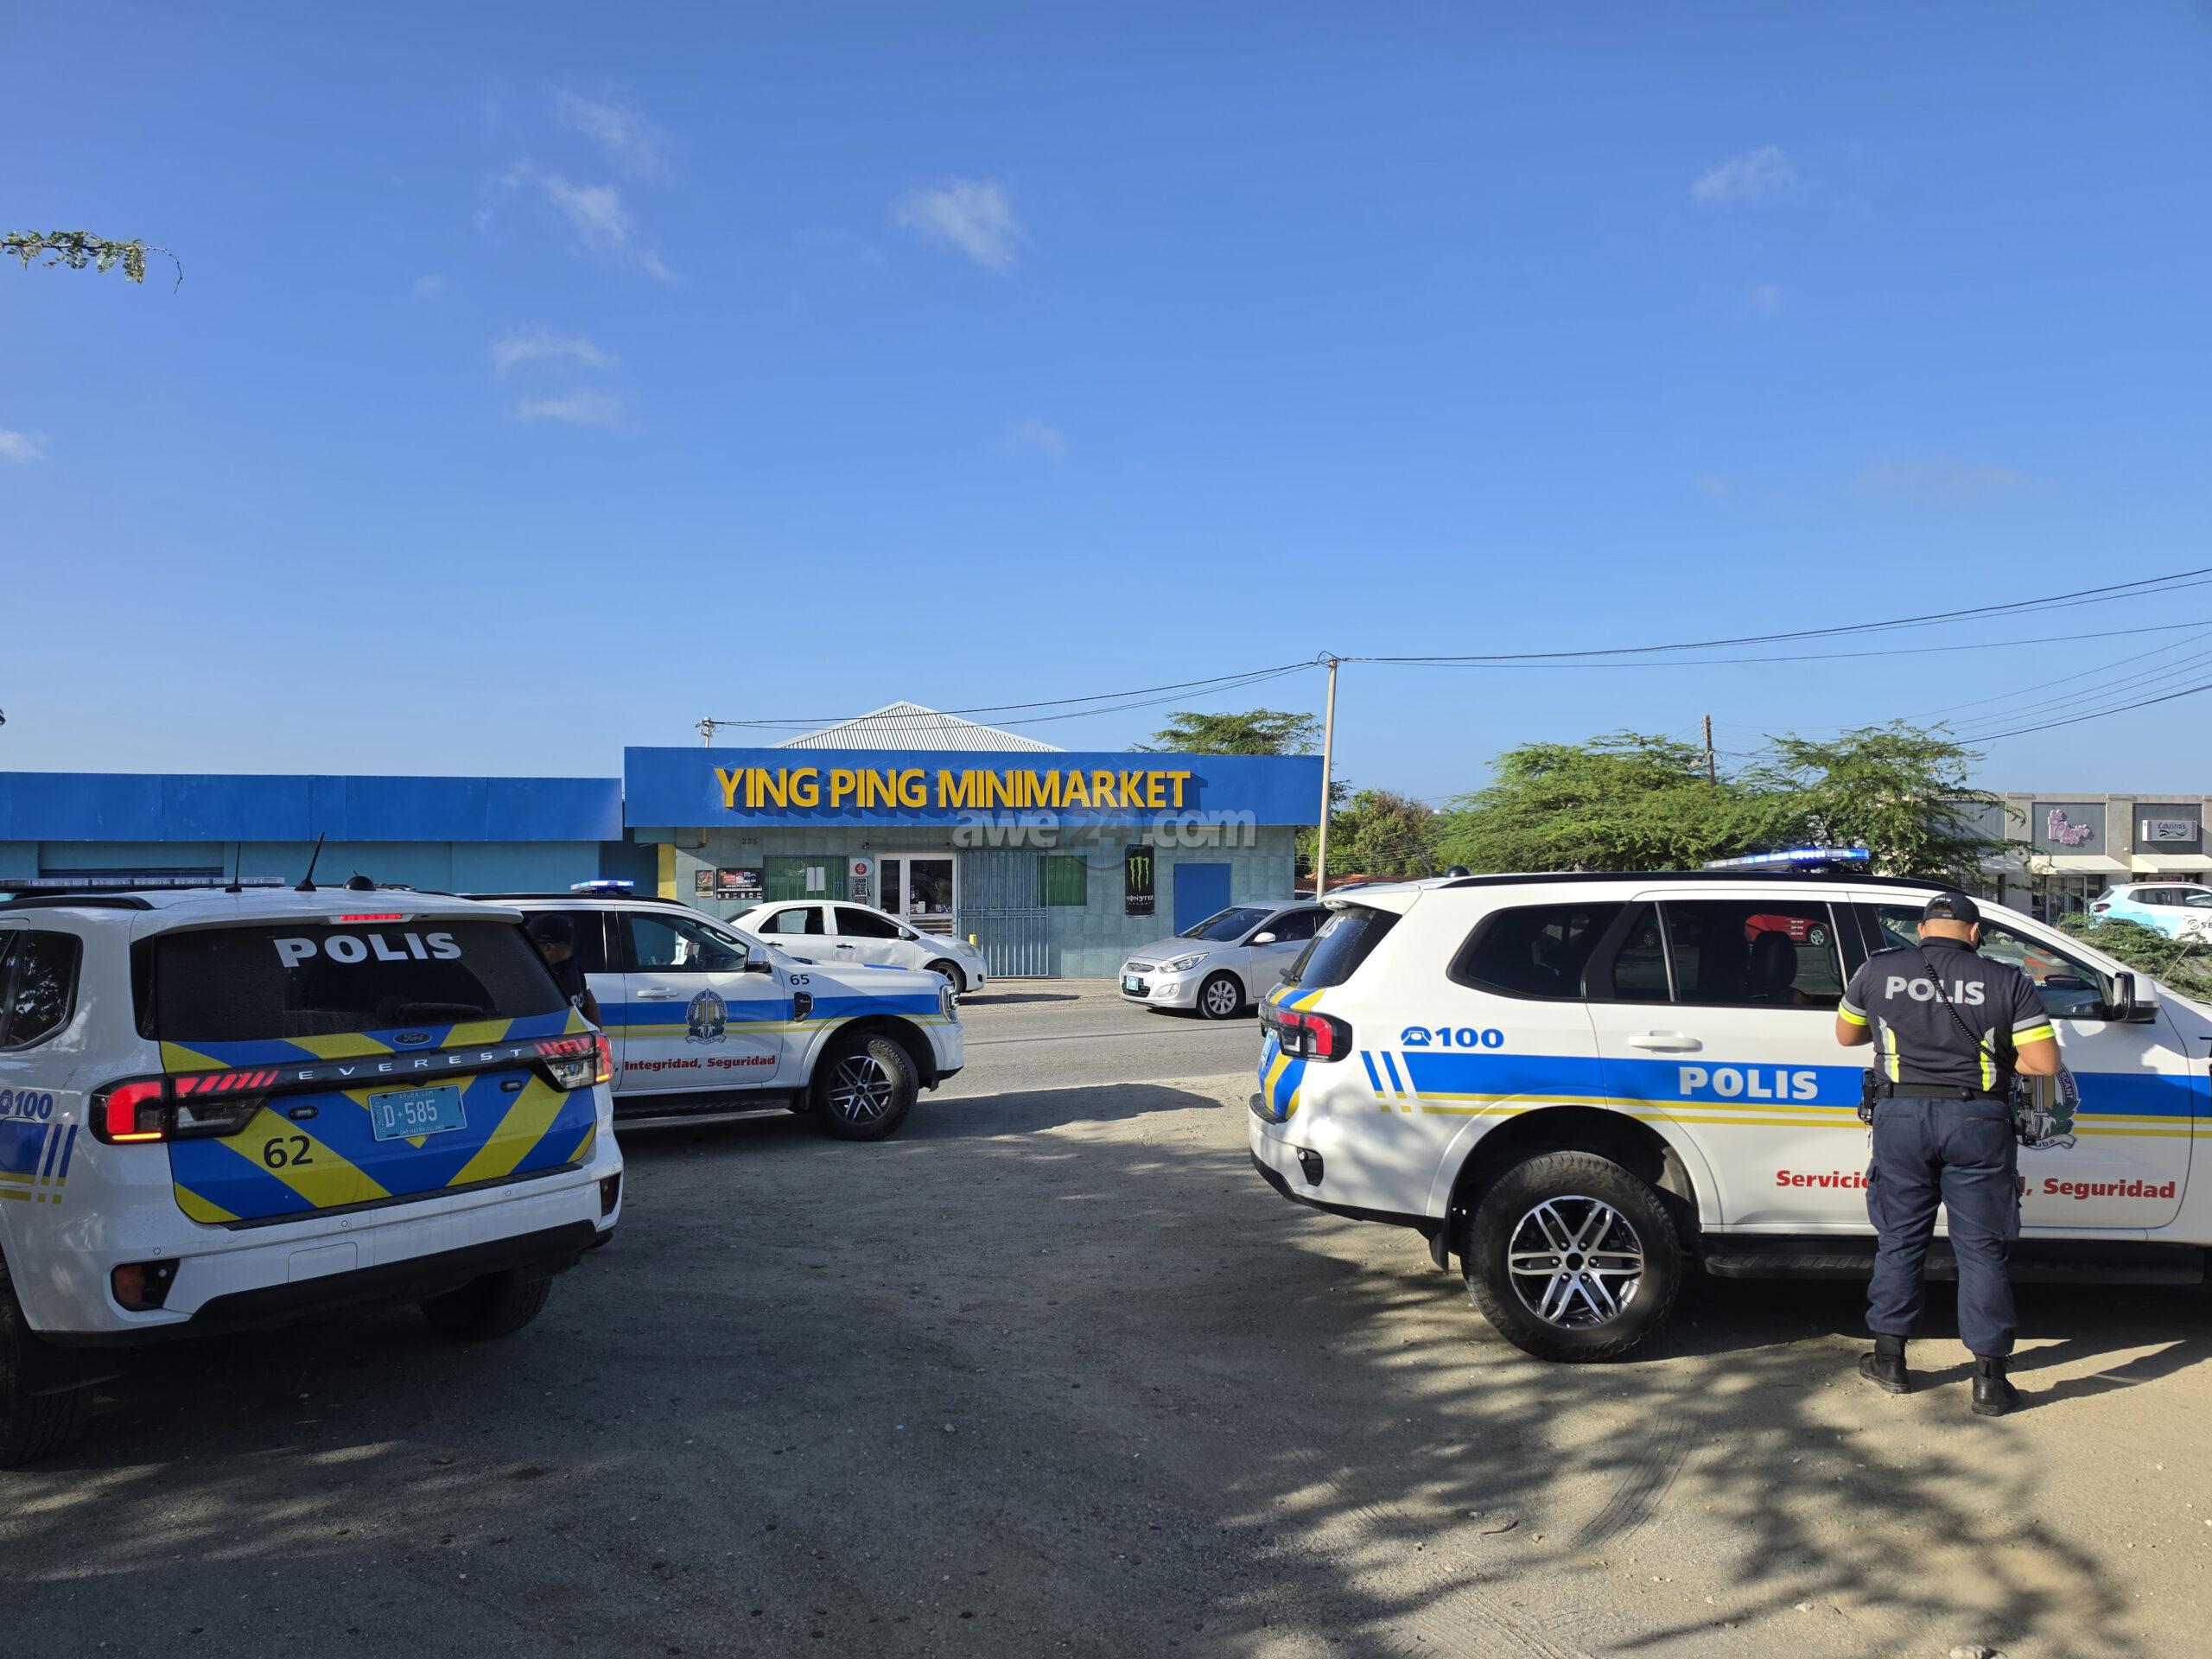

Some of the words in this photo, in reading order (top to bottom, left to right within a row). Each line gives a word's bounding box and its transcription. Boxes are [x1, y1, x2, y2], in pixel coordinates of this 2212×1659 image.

[714, 767, 819, 808] YING
[830, 768, 927, 808] PING
[938, 769, 1191, 809] MINIMARKET
[741, 836, 759, 845] 235
[273, 932, 462, 968] POLIS
[790, 974, 810, 985] 65
[1885, 976, 1986, 1006] POLIS
[1434, 1027, 1504, 1049] 100
[298, 1048, 523, 1081] EVEREST
[625, 1057, 702, 1071] Integridad,
[707, 1054, 776, 1069] Seguridad
[1679, 1066, 1819, 1100] POLIS
[15, 1090, 54, 1120] 100
[263, 1135, 314, 1169] 62
[2043, 1177, 2176, 1200] Seguridad
